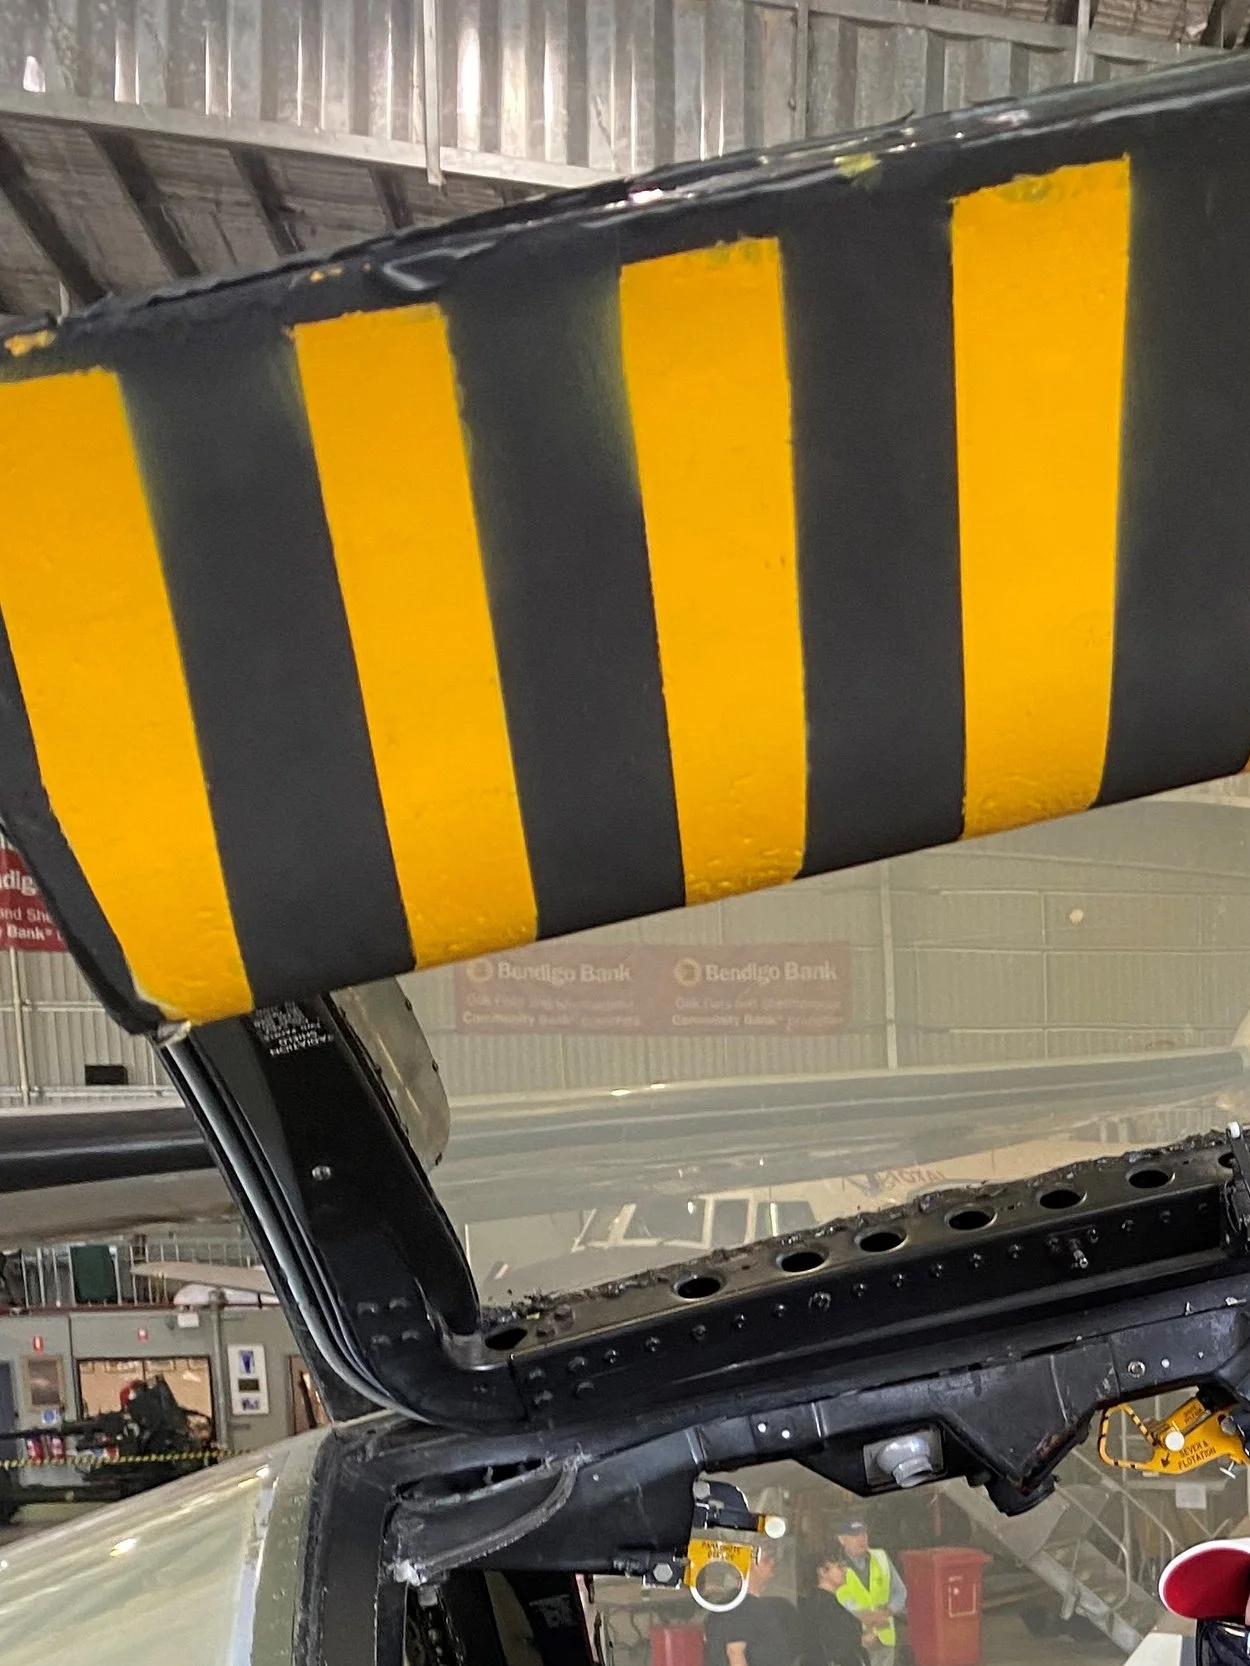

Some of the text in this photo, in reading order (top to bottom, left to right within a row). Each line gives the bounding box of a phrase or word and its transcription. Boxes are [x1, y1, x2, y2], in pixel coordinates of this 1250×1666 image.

[498, 962, 632, 987] Bendigo Bank
[705, 961, 838, 988] Bendigo Bank
[1178, 1446, 1217, 1470] FLOTATION
